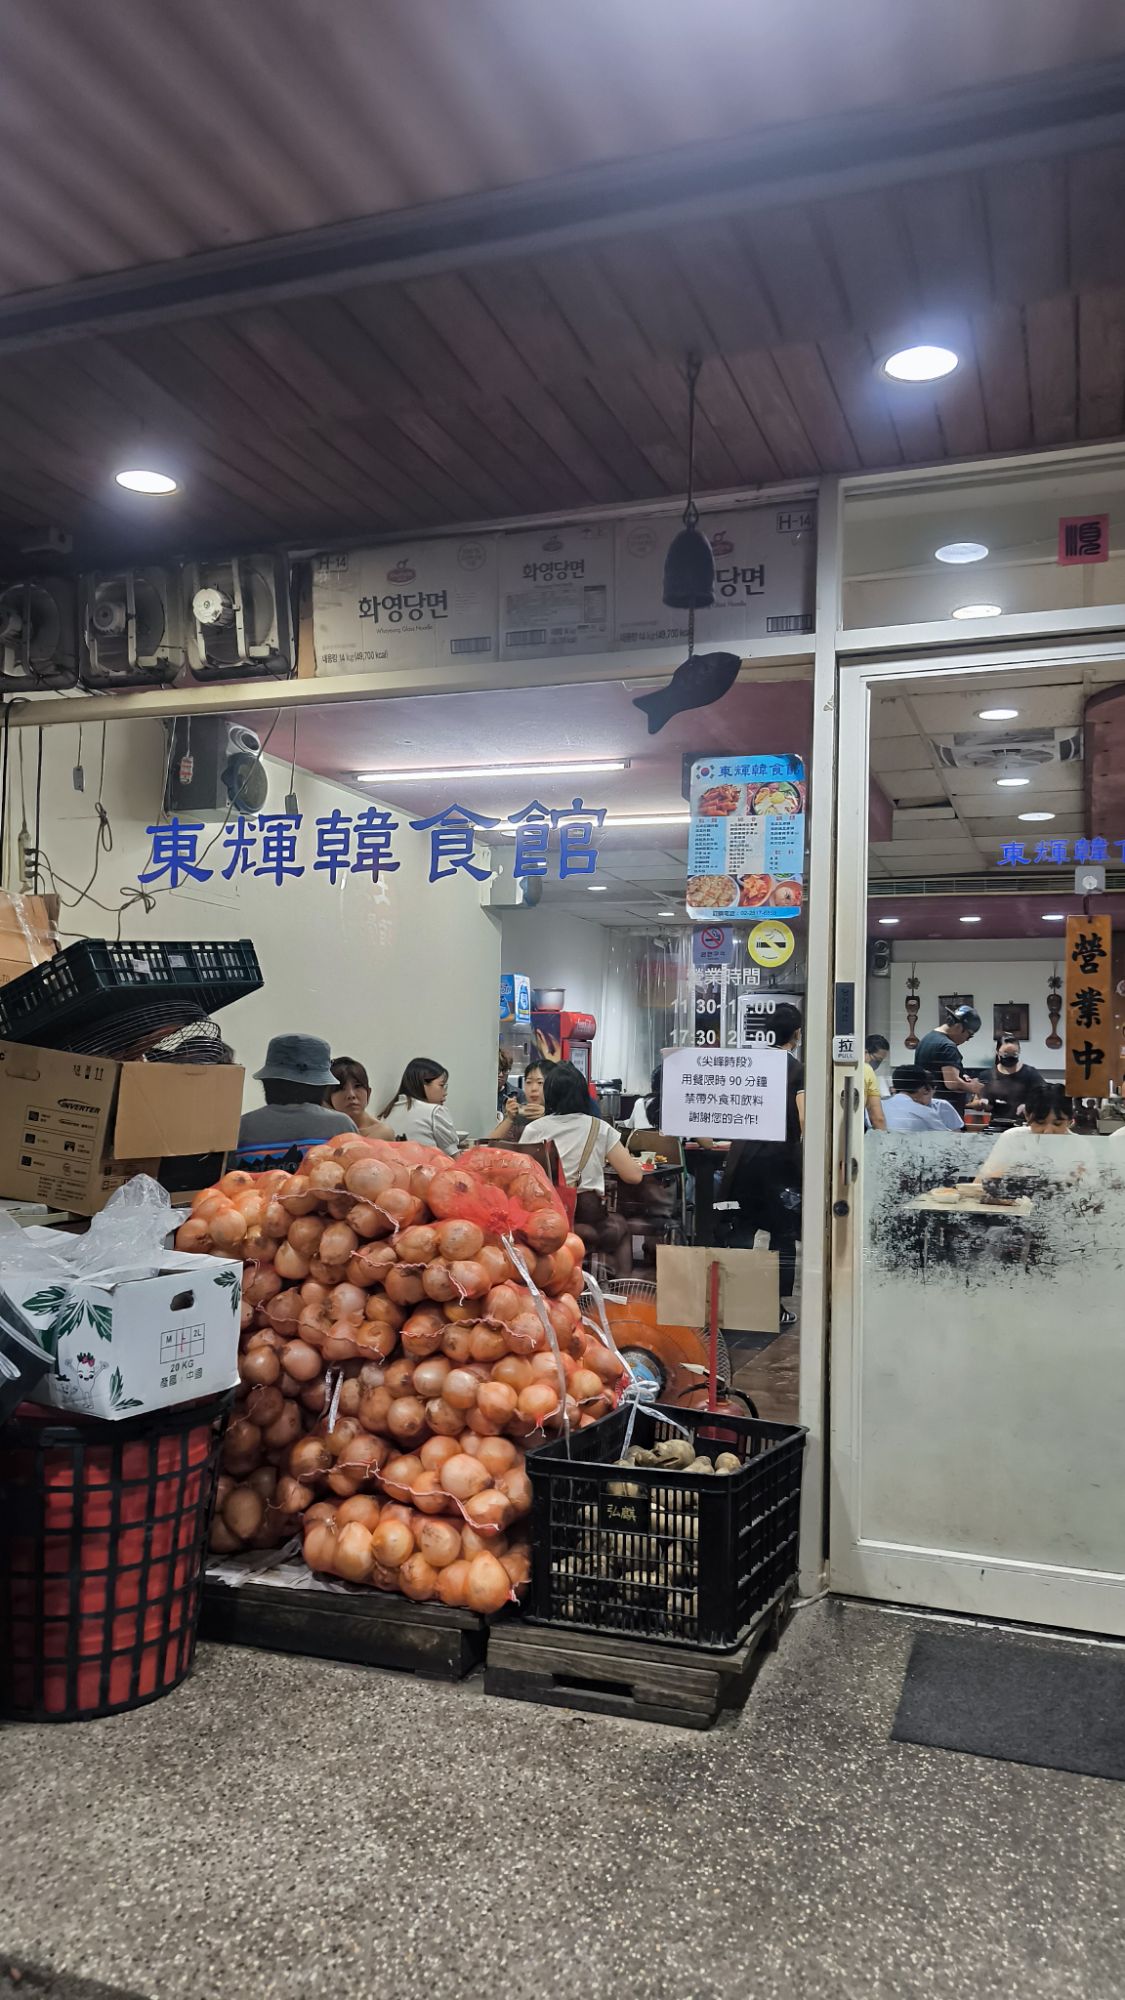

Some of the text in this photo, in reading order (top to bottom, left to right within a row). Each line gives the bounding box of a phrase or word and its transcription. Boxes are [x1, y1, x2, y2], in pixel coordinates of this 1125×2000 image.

[779, 514, 811, 530] H-14
[523, 559, 585, 582] 화영당면
[716, 564, 765, 597] 당면
[358, 589, 449, 624] 화영당면
[137, 797, 607, 888] 東輝韓食館
[687, 967, 761, 985] 營業時間
[670, 999, 776, 1014] 1130~15:00
[1069, 933, 1107, 1081] 營業中
[838, 1039, 854, 1053] 拉
[681, 1073, 768, 1087] 用餐限時 90 分鐘
[684, 1092, 764, 1106] 禁帶外食和飲料
[61, 1100, 101, 1115] INVERTER
[166, 1335, 172, 1344] M
[193, 1329, 201, 1338] 2L
[170, 1359, 194, 1373] 20 KG
